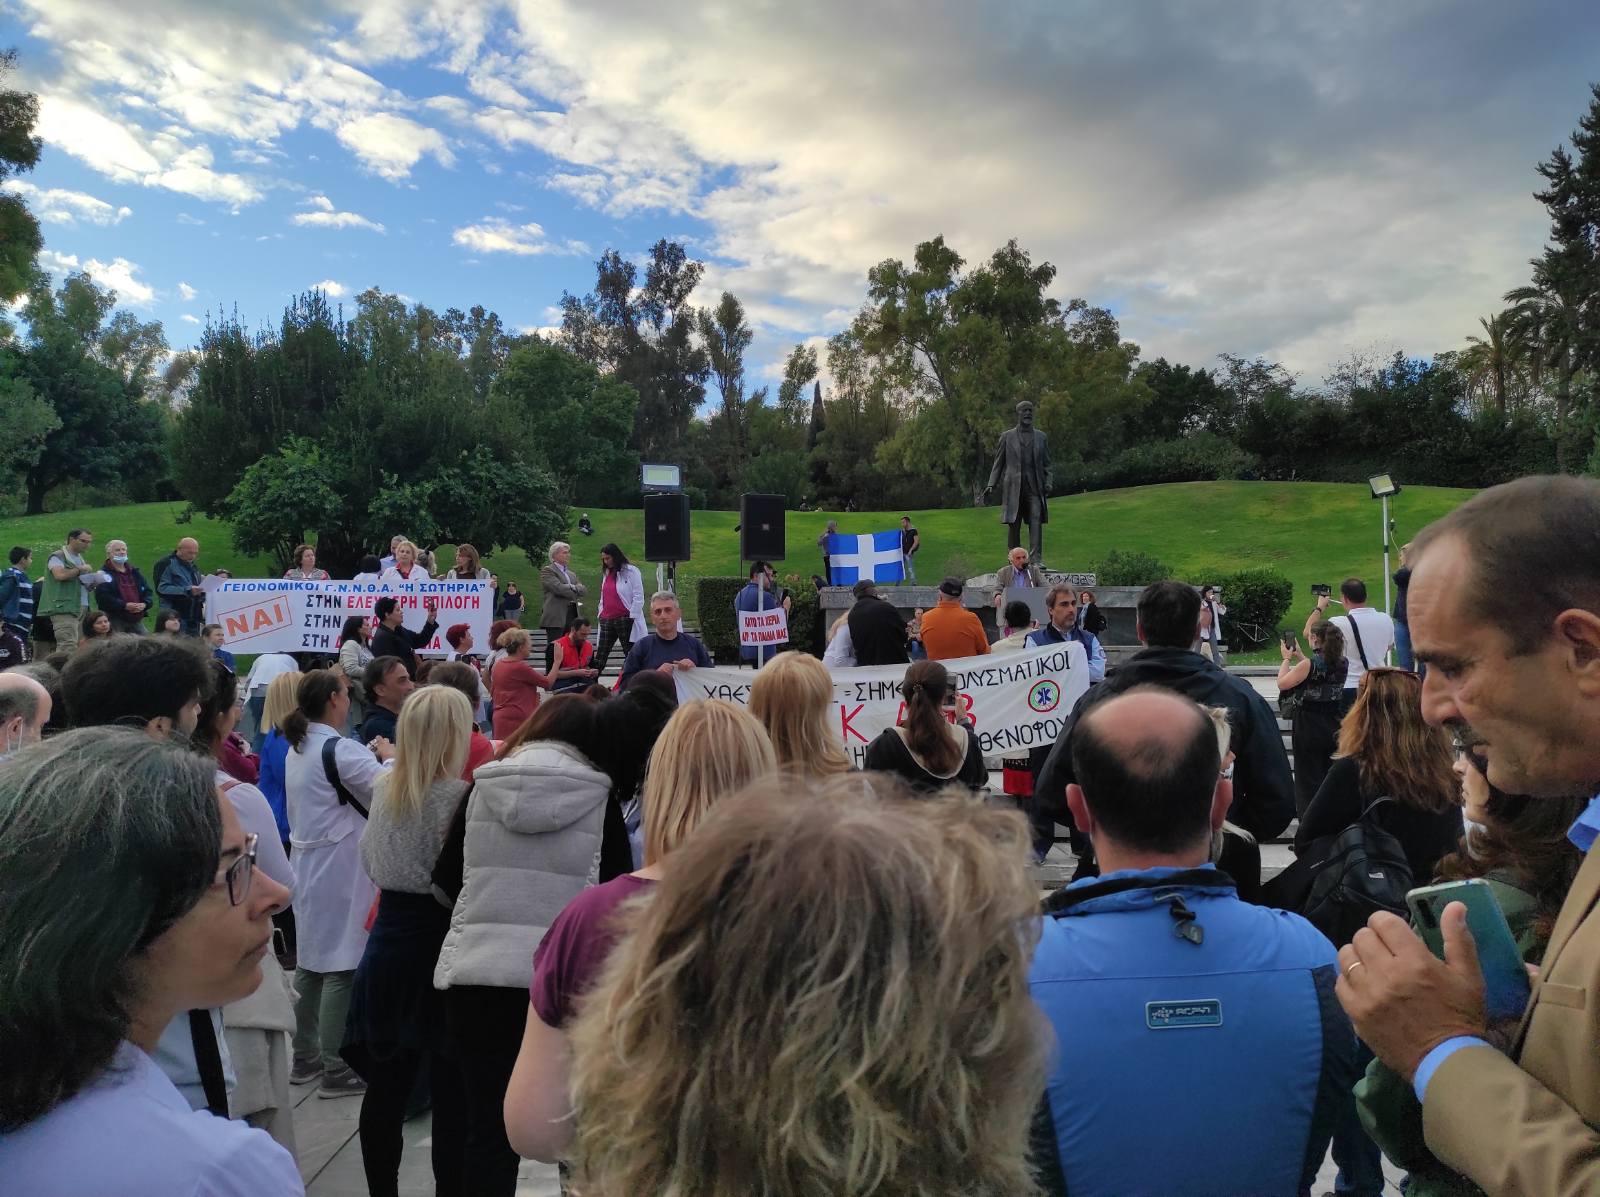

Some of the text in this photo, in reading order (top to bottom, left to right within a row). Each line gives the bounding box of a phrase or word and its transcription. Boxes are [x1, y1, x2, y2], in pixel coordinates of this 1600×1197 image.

[217, 582, 320, 592] ΓΕΙΟΝΟΜΙΚΟΙ
[305, 594, 342, 609] ΣΤΗΝ
[225, 603, 285, 637] ΝΑΙ
[304, 613, 341, 629] ΣΤΗΝ
[302, 634, 330, 648] ΣΤΗ
[956, 650, 1071, 691] ΟΛΥΣΜΑΤΙΚΟΙ
